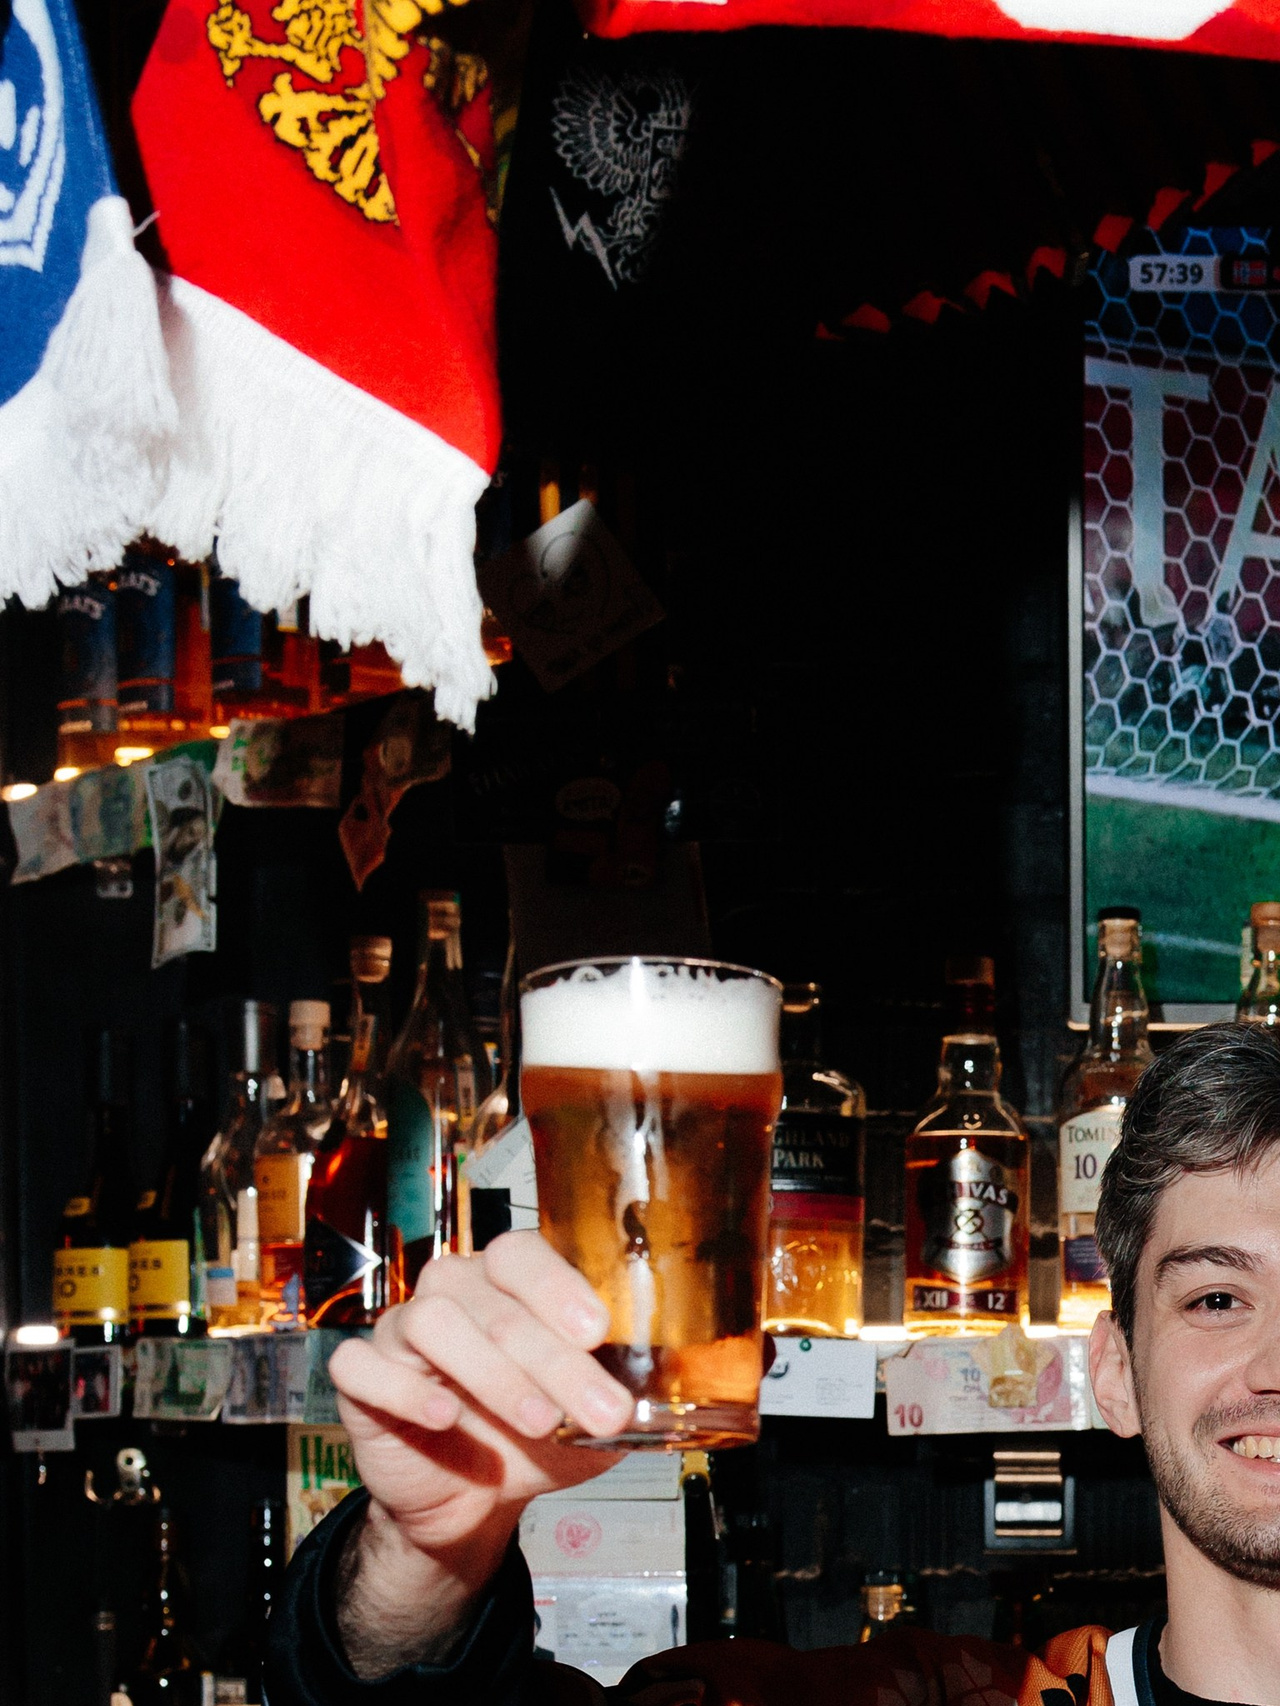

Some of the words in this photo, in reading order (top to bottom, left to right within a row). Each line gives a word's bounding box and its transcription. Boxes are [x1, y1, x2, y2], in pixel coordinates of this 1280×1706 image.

[1139, 262, 1203, 285] 57:39
[772, 1148, 826, 1170] PARK
[1075, 1153, 1098, 1179] 10
[987, 1291, 1006, 1310] 12
[893, 1404, 924, 1428] 10
